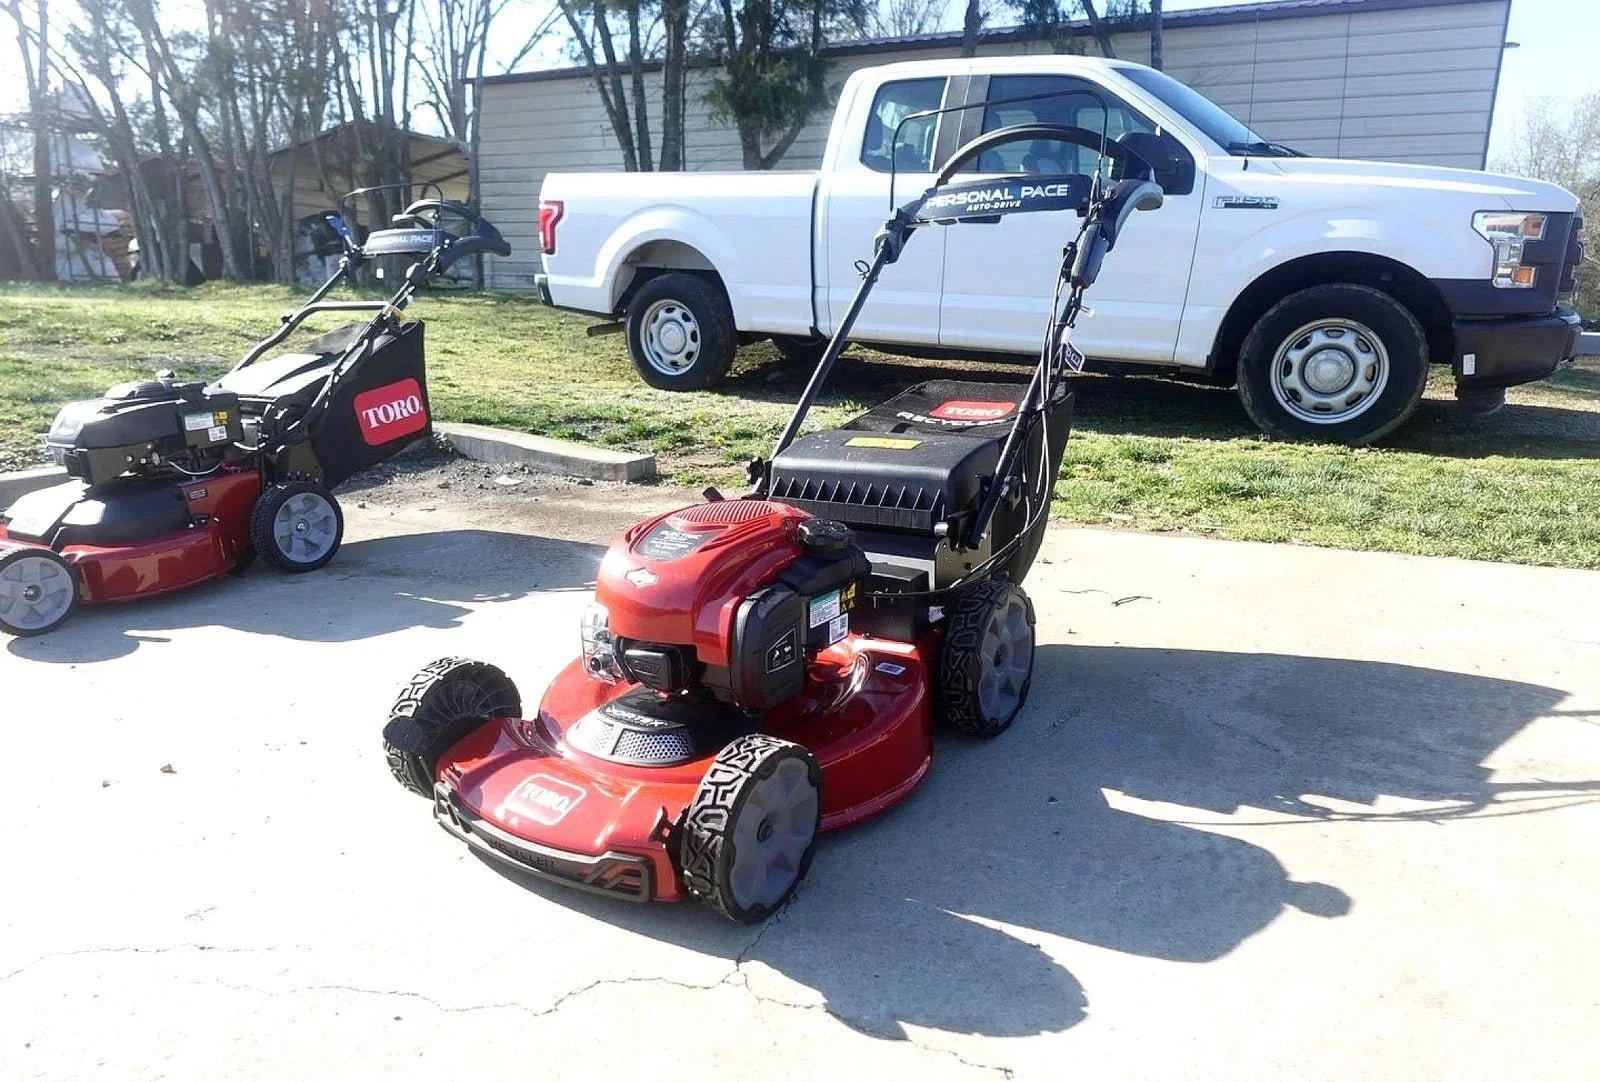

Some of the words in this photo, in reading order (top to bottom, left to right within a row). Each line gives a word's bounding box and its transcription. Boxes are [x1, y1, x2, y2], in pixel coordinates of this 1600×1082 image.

[926, 187, 1014, 209] PERSONAL
[1021, 184, 1069, 198] PACE
[966, 201, 1022, 212] AUTO-DRIVE
[410, 234, 433, 243] PACE
[362, 395, 420, 429] TORO
[943, 406, 1004, 417] TORO
[519, 782, 571, 814] TORO
